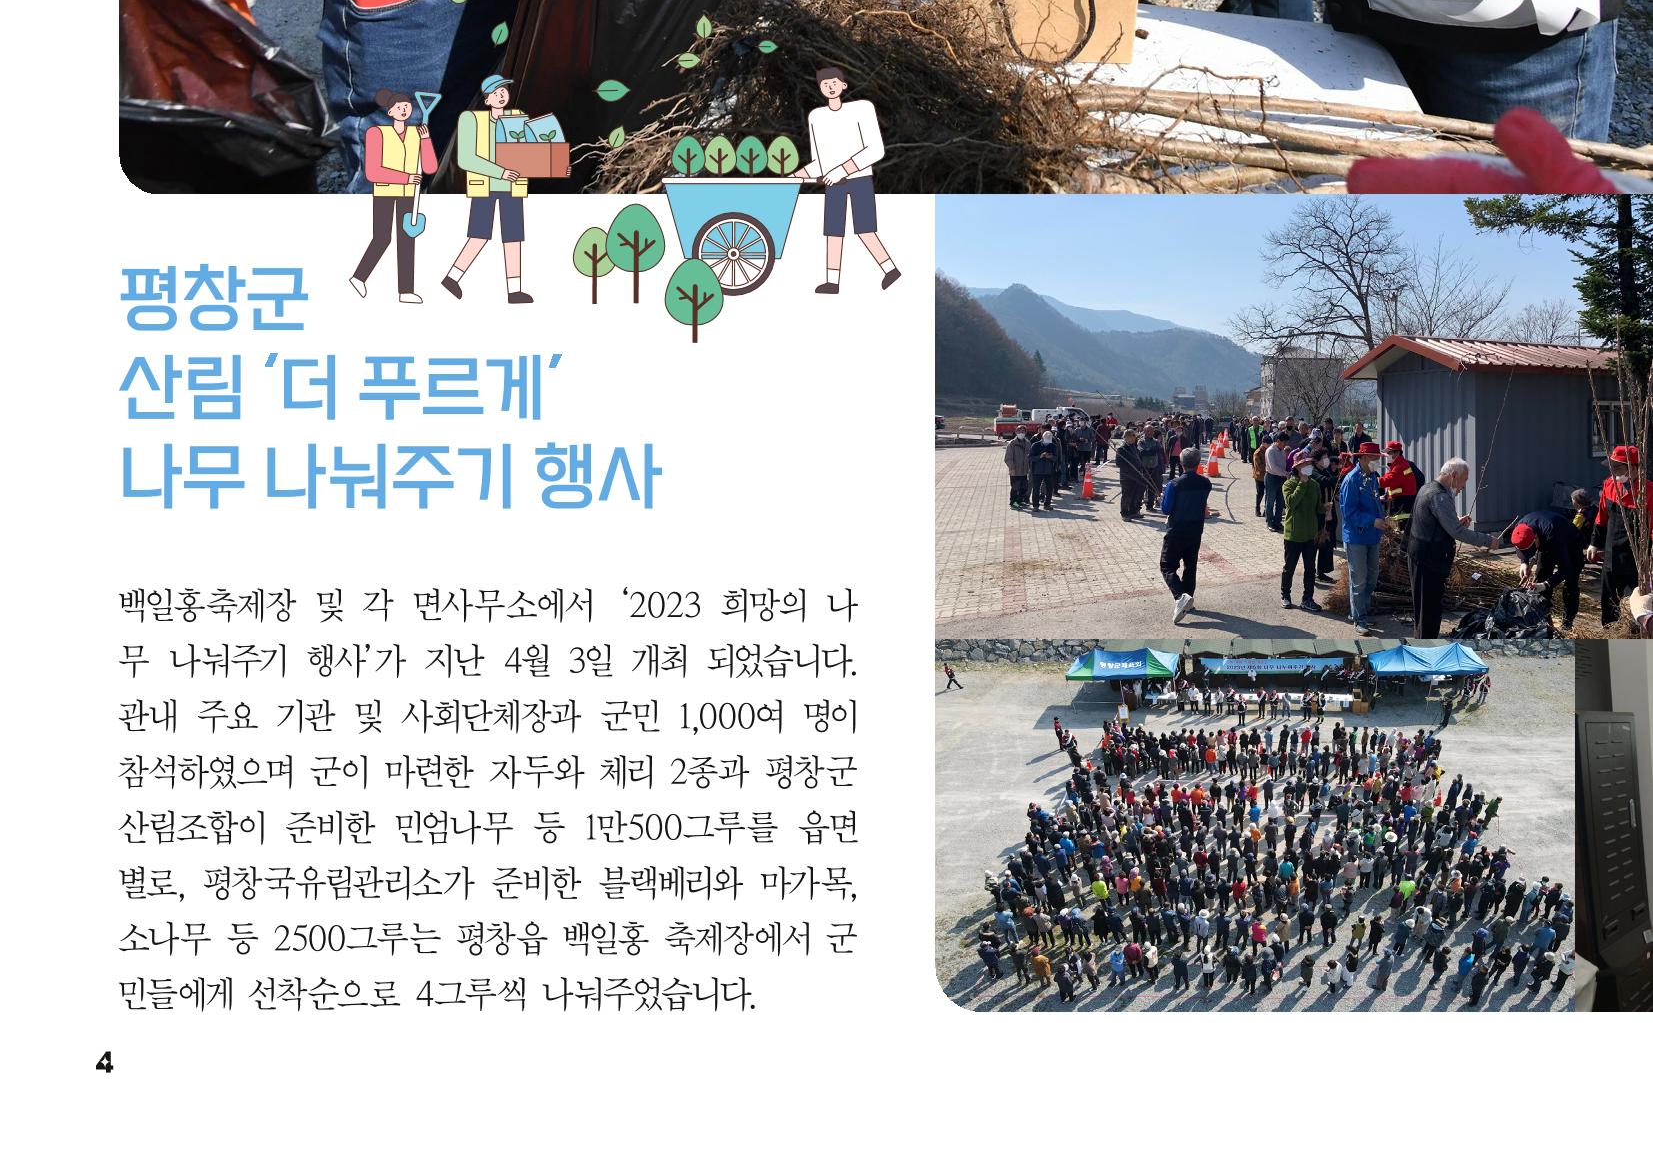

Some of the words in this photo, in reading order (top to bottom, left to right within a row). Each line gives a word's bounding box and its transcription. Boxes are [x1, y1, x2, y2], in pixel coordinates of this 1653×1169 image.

[121, 264, 308, 331] 평창군
[119, 355, 241, 419] 산림
[123, 444, 244, 509] 나무
[267, 444, 511, 509] 나눠주기
[535, 442, 662, 509] 행사
[119, 588, 296, 623] 백일홍축제장
[317, 588, 343, 623] 및
[363, 588, 394, 622] 각
[413, 588, 592, 623] 면사무소에서
[721, 588, 805, 623] 희망의
[827, 588, 858, 623] 나
[119, 646, 149, 678] 무
[170, 643, 285, 678] 나눠주기
[425, 643, 485, 678] 지난
[505, 644, 550, 677] 4월
[570, 644, 613, 677] 3일
[632, 644, 686, 678] 개최
[708, 643, 856, 678] 되었습니다.
[119, 699, 176, 733] 관내
[198, 700, 258, 734] 주요
[277, 699, 336, 733] 기관
[355, 699, 381, 734] 및
[401, 699, 581, 734] 사회단체장과
[601, 699, 660, 732] 군민
[681, 699, 782, 735] 1,000여
[804, 699, 856, 734] 명이
[118, 754, 292, 789] 참석하였으며
[310, 755, 367, 789] 군이
[385, 755, 474, 789] 마련한
[490, 755, 585, 789] 자두와
[600, 755, 652, 789] 체리
[671, 755, 749, 789] 2종과
[766, 755, 857, 789] 평창군
[118, 810, 264, 845] 산림조합이
[286, 810, 375, 845] 준비한
[396, 810, 513, 845] 민엄나무
[534, 812, 565, 844] 등
[587, 810, 778, 845] 1만500그루를
[799, 810, 858, 845] 읍면
[119, 866, 184, 902] 별로,
[204, 866, 475, 900] 평창국유림관리소가
[492, 866, 581, 900] 준비한
[599, 866, 743, 901] 블랙베리와
[761, 866, 856, 902] 마가목,
[119, 921, 211, 956] 소나무
[228, 923, 258, 955] 등
[275, 923, 441, 956] 2500그루는
[457, 921, 548, 956] 평창읍
[563, 921, 649, 956] 백일홍
[665, 921, 809, 957] 축제장에서
[826, 923, 857, 953] 군
[119, 977, 232, 1012] 민들에게
[249, 977, 400, 1012] 선착순으로
[416, 977, 525, 1012] 4그루씩
[543, 977, 755, 1012] 나눠주었습니다.
[96, 1051, 114, 1073] 4
